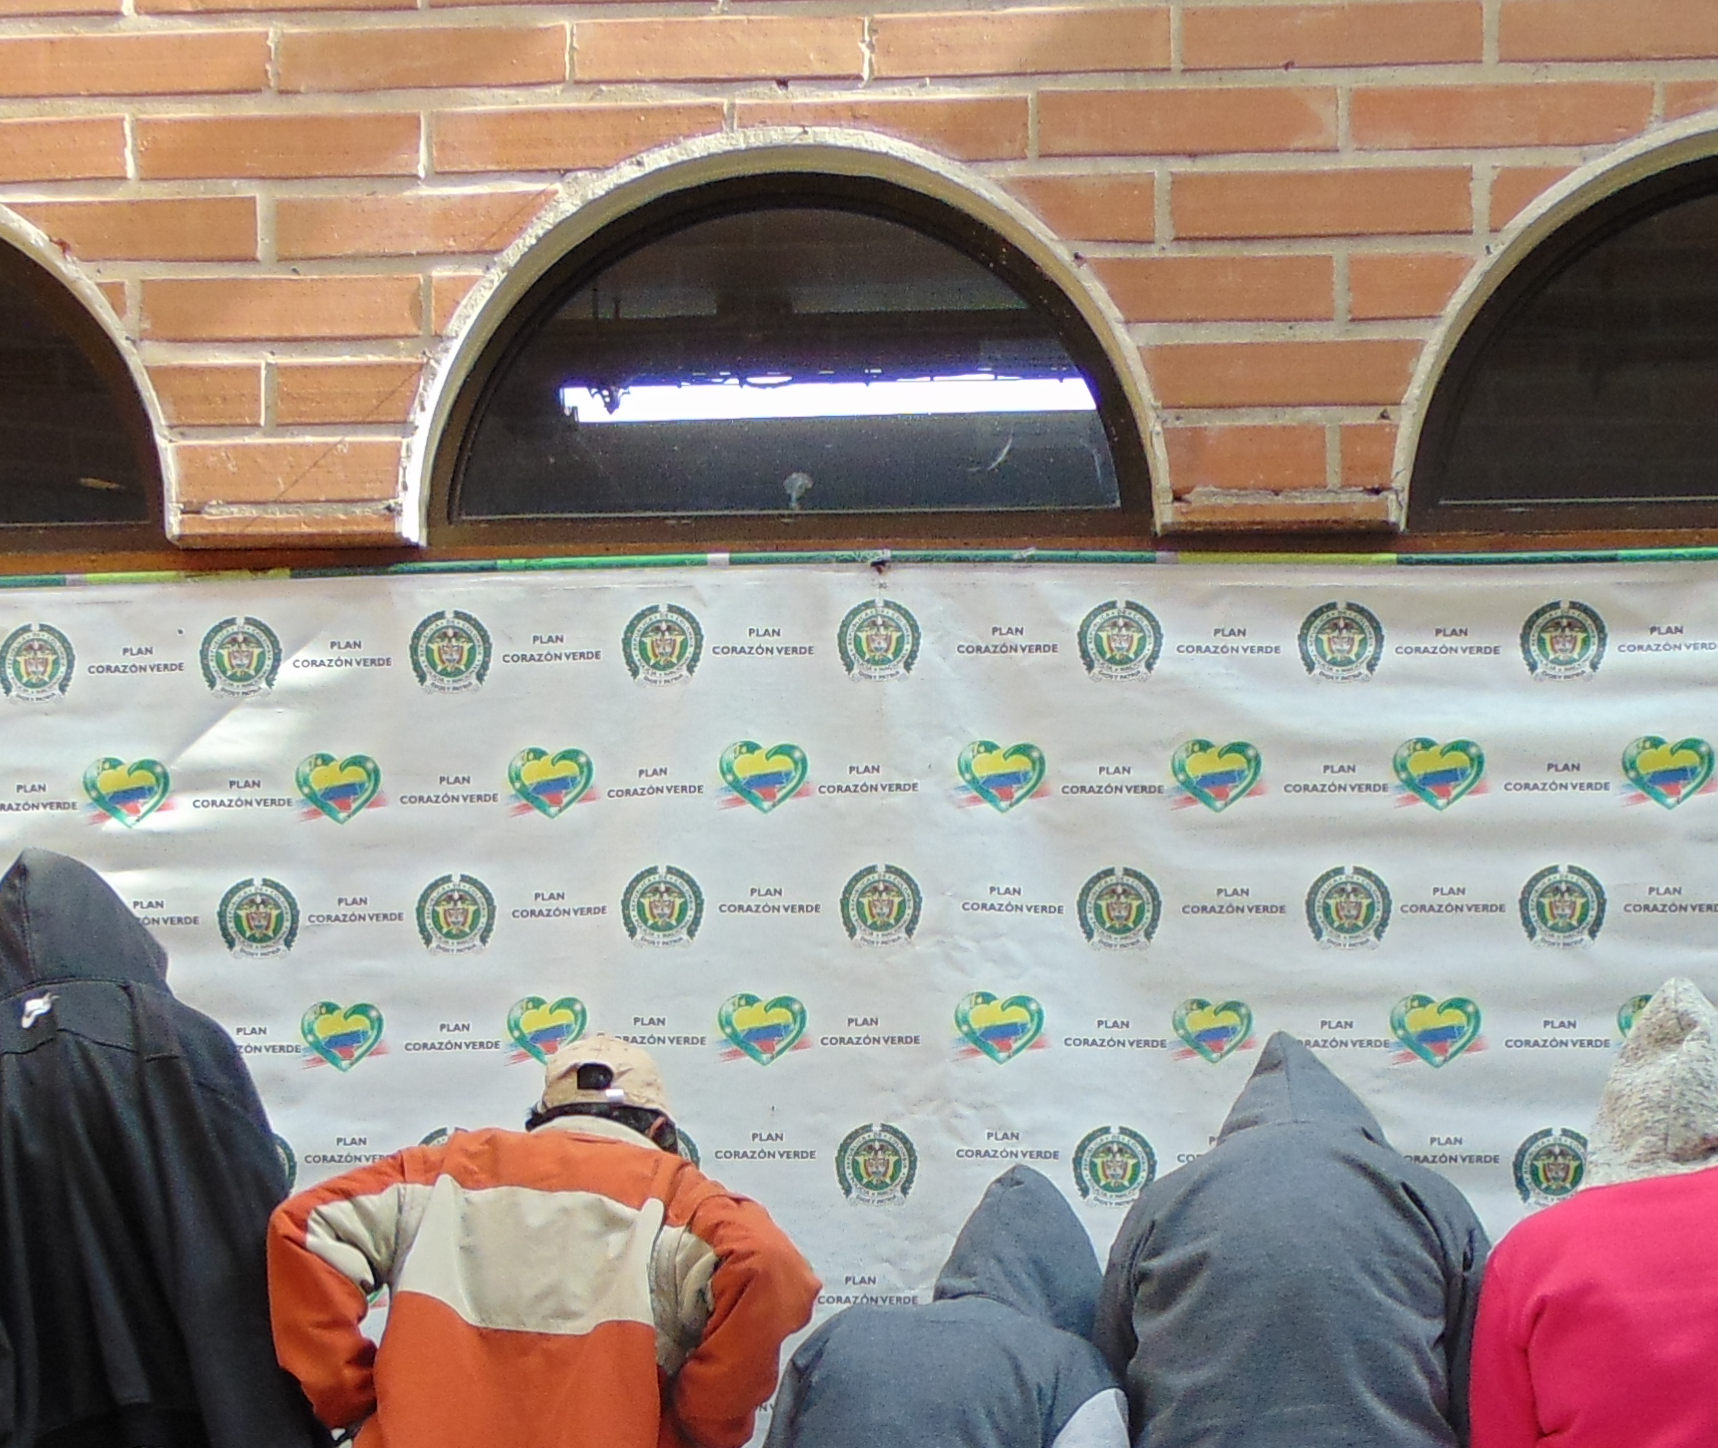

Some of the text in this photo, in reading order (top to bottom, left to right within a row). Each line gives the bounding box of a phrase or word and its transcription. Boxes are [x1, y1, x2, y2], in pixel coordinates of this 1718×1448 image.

[748, 627, 781, 638] PLAN
[991, 626, 1024, 636] PLAN
[1213, 627, 1247, 638] PLAN
[1434, 627, 1469, 638] PLAN
[1648, 626, 1684, 636] PLAN
[329, 640, 362, 650] PLAN
[532, 634, 564, 645] PLAN
[712, 643, 815, 656] CORAZÓN VERDE
[956, 642, 1058, 655] CORAZÓN VERDE
[1176, 642, 1281, 655] CORAZÓN VERDE
[1394, 643, 1501, 656] CORAZÓN VERDE
[1617, 638, 1683, 653] CORAZÓN
[122, 646, 154, 657] PLAN
[502, 650, 601, 664] CORAZÓN VERDE
[292, 655, 392, 669] CORAZÓN VERDE
[87, 662, 185, 675] CORAZÓN VERDE
[638, 767, 668, 778] PLAN
[848, 764, 881, 775] PLAN
[1098, 765, 1132, 776] PLAN
[1322, 764, 1356, 774] PLAN
[1546, 762, 1581, 773] PLAN
[228, 779, 261, 790] PLAN
[439, 775, 471, 785] PLAN
[1503, 779, 1611, 792] CORAZÓN VERDE
[16, 784, 47, 794] PLAN
[606, 784, 704, 799] CORAZÓN VERDE
[818, 781, 919, 795] CORAZÓN VERDE
[1061, 782, 1164, 795] CORAZÓN VERDE
[1283, 781, 1389, 794] CORAZÓN VERDE
[192, 795, 292, 809] CORAZÓN VERDE
[399, 792, 499, 805] CORAZÓN VERDE
[40, 801, 78, 811] VERDE
[750, 887, 783, 897] PLAN
[989, 885, 1022, 896] PLAN
[1216, 887, 1250, 898] PLAN
[1432, 886, 1466, 896] PLAN
[1648, 886, 1683, 896] PLAN
[337, 896, 368, 907] PLAN
[534, 892, 565, 902] PLAN
[132, 900, 165, 909] PLAN
[718, 901, 821, 914] CORAZÓN VERDE
[961, 899, 1064, 915] CORAZÓN VERDE
[1181, 902, 1286, 915] CORAZÓN VERDE
[1400, 901, 1506, 914] CORAZÓN VERDE
[1623, 901, 1689, 913] CORAZÓN
[307, 910, 404, 925] CORAZÓN VERDE
[511, 905, 607, 919] CORAZÓN VERDE
[161, 915, 201, 926] VERDE
[633, 1016, 666, 1027] PLAN
[847, 1017, 879, 1027] PLAN
[1096, 1019, 1130, 1029] PLAN
[1320, 1019, 1354, 1030] PLAN
[1543, 1019, 1577, 1030] PLAN
[235, 1026, 267, 1036] PLAN
[439, 1023, 471, 1033] PLAN
[404, 1038, 500, 1052] CORAZÓN VERDE
[667, 1035, 706, 1046] VERDE
[820, 1033, 921, 1046] CORAZÓN VERDE
[1063, 1035, 1168, 1049] CORAZÓN VERDE
[1350, 1038, 1391, 1049] VERDE
[1504, 1036, 1611, 1049] CORAZÓN VERDE
[263, 1044, 302, 1054] VERDE
[336, 1137, 367, 1147] PLAN
[751, 1132, 784, 1142] PLAN
[986, 1131, 1020, 1142] PLAN
[1429, 1136, 1463, 1147] PLAN
[304, 1152, 363, 1165] CORAZÓN
[714, 1146, 817, 1160] CORAZÓN VERDE
[955, 1146, 1060, 1160] CORAZÓN VERDE
[1459, 1154, 1500, 1165] VERDE
[844, 1275, 877, 1286] PLAN
[814, 1291, 918, 1306] CORAZÓN VERDE
